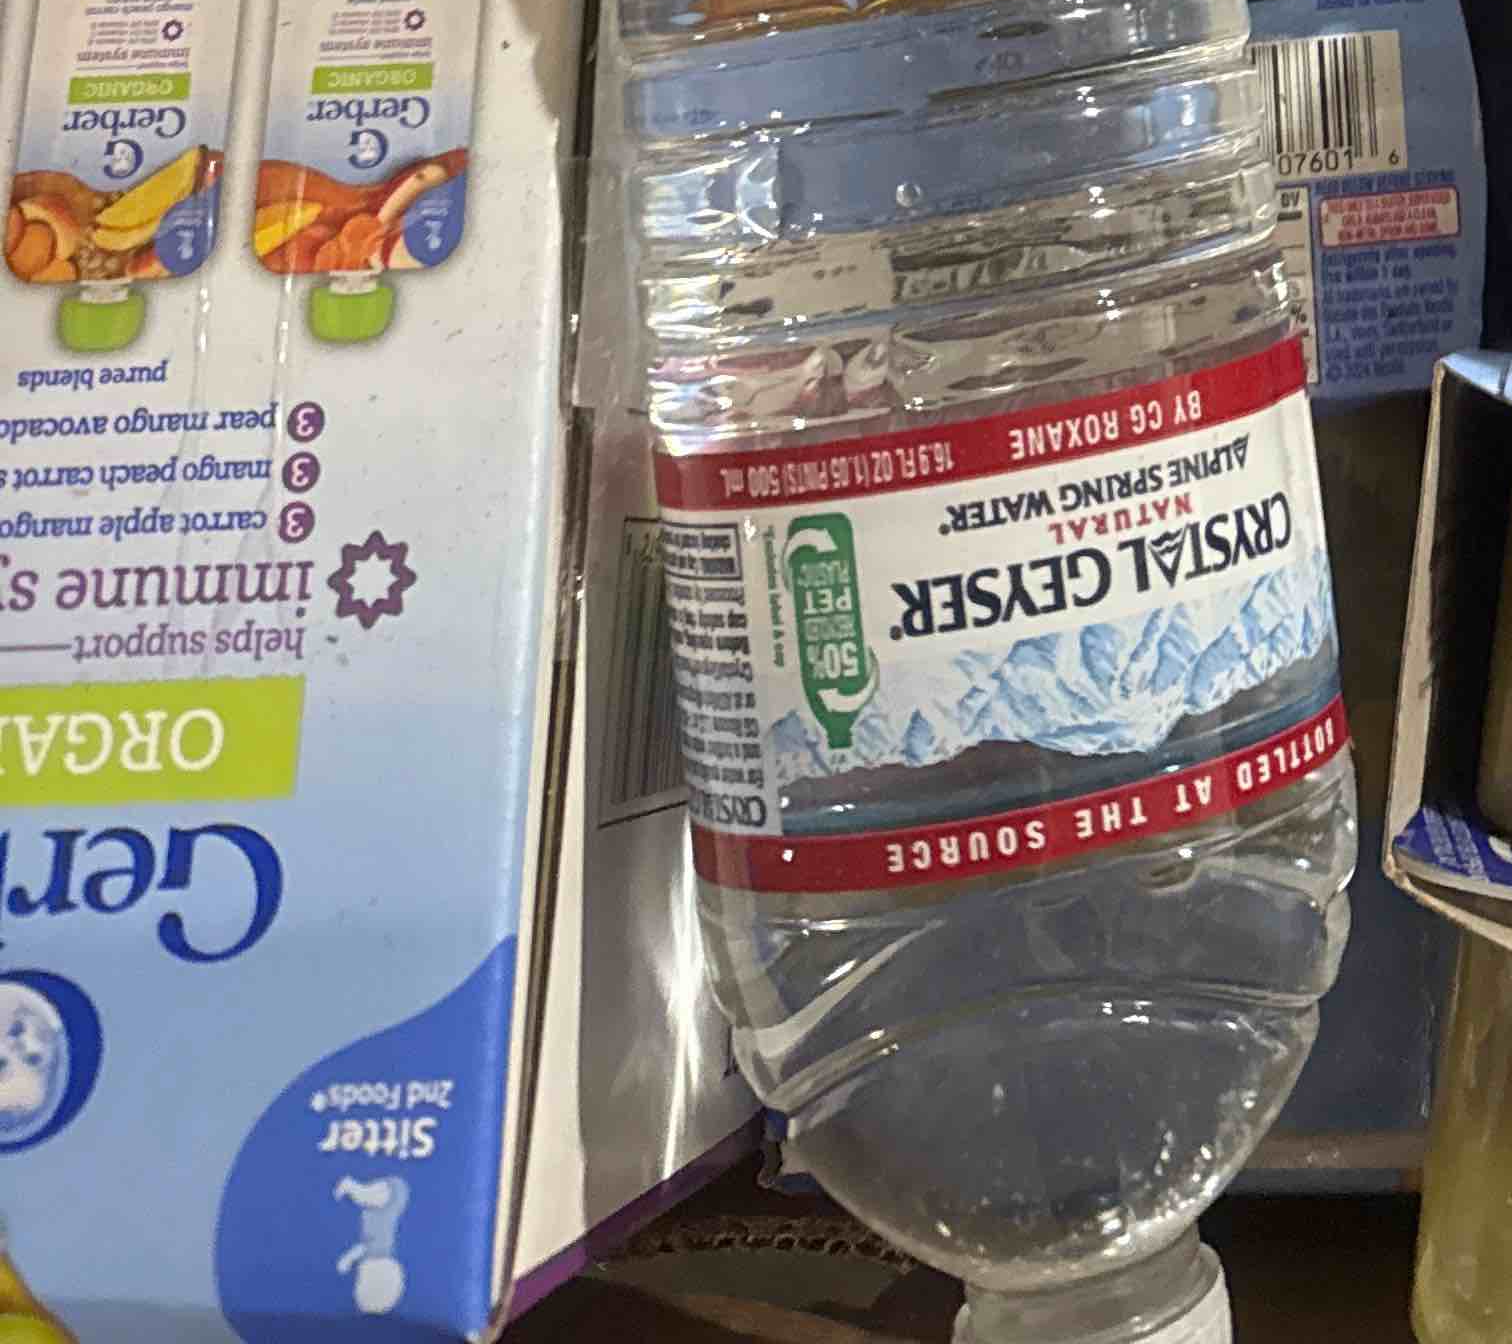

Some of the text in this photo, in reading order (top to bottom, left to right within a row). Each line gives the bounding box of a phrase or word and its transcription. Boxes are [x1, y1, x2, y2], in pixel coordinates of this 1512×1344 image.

[83, 80, 174, 98] ORGANIC
[328, 70, 418, 89] ORGANIC
[63, 106, 186, 140] Gerber
[307, 96, 431, 128] Gerber
[1276, 150, 1400, 175] 07601 6
[17, 358, 169, 391] puree blends
[114, 406, 208, 435] mango
[212, 403, 278, 431] pear
[1129, 400, 1163, 435] CG
[1173, 389, 1203, 425] BY
[1008, 410, 1120, 461] ROXANE
[100, 459, 178, 490] peach
[183, 458, 273, 482] mango
[870, 450, 893, 482] OZ
[896, 447, 915, 479] FL
[918, 441, 954, 475] 16.9
[12, 464, 94, 487] carrot
[747, 465, 781, 497] 500
[947, 432, 1249, 534] ALPINE SPRING WATER
[0, 511, 268, 541] carrot apple mango
[1048, 492, 1194, 545] NATURAL
[893, 491, 1292, 638] CRYSTAL GEYSER
[55, 560, 314, 618] immune
[803, 587, 853, 611] PET
[72, 626, 306, 662] helps support
[806, 643, 860, 679] 50%
[1174, 775, 1213, 812] AT
[1075, 794, 1149, 839] THE
[886, 824, 1047, 874] SOURCE
[0, 822, 284, 964] Ger
[410, 1079, 455, 1109] 2nd
[319, 1117, 437, 1160] Sitter
